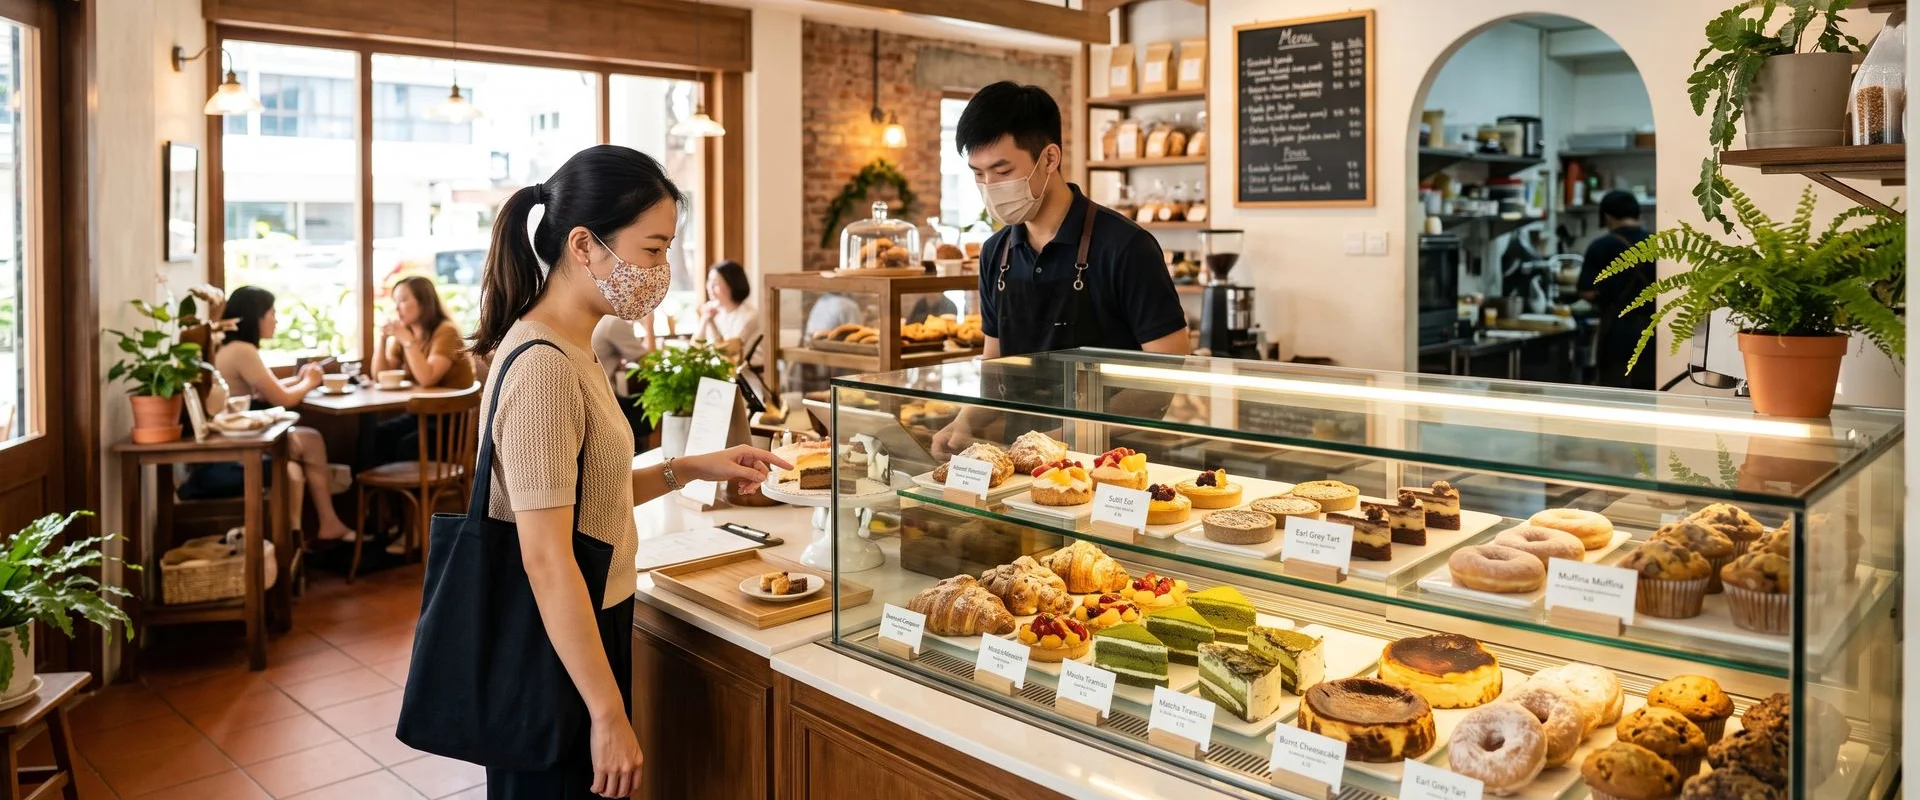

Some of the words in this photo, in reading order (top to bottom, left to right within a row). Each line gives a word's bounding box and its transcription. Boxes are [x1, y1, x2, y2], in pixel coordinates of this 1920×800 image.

[1278, 28, 1314, 45] Menu
[1295, 528, 1308, 537] Earl
[1309, 531, 1325, 542] Grey
[1327, 534, 1340, 543] Tart
[1085, 675, 1108, 689] Tiramisu
[1159, 699, 1181, 711] Matcha
[1279, 735, 1298, 748] Burnt
[1299, 742, 1340, 760] Cheesecake
[1415, 775, 1430, 786] Earl
[1431, 780, 1449, 794] Grey
[1451, 785, 1467, 798] Tart
